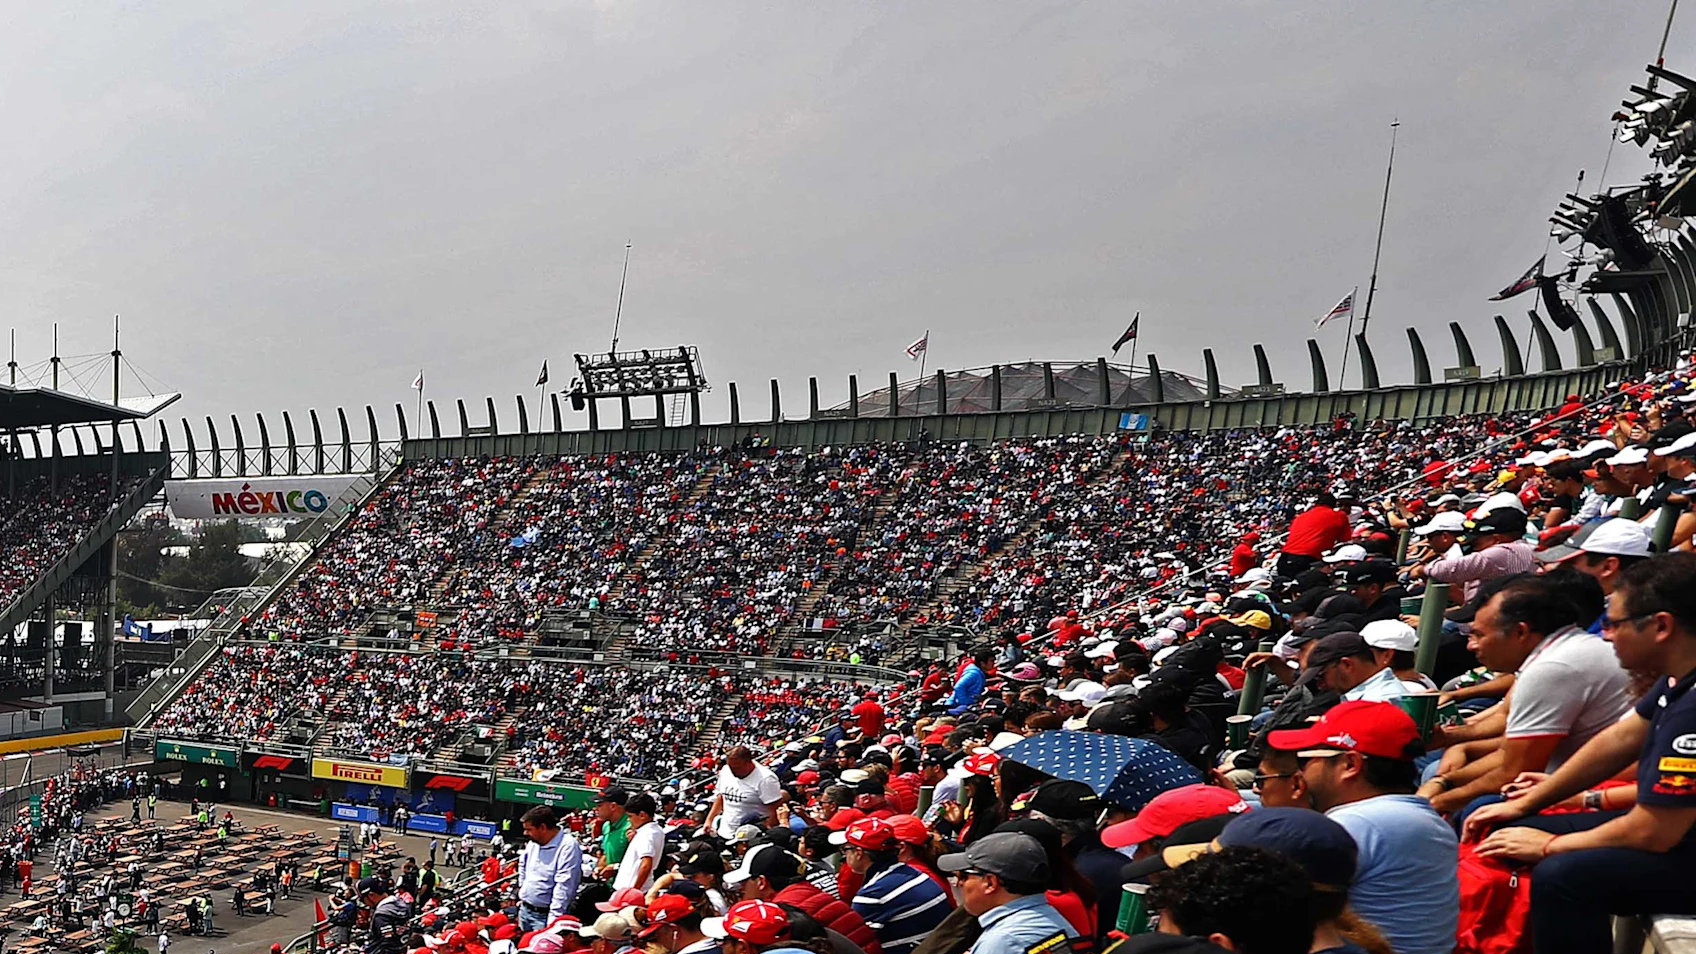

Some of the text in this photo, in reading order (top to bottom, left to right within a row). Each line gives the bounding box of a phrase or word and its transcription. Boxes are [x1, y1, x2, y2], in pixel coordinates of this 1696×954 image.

[165, 752, 225, 766] ROLEX ROLEX
[333, 763, 383, 782] PIRELLI
